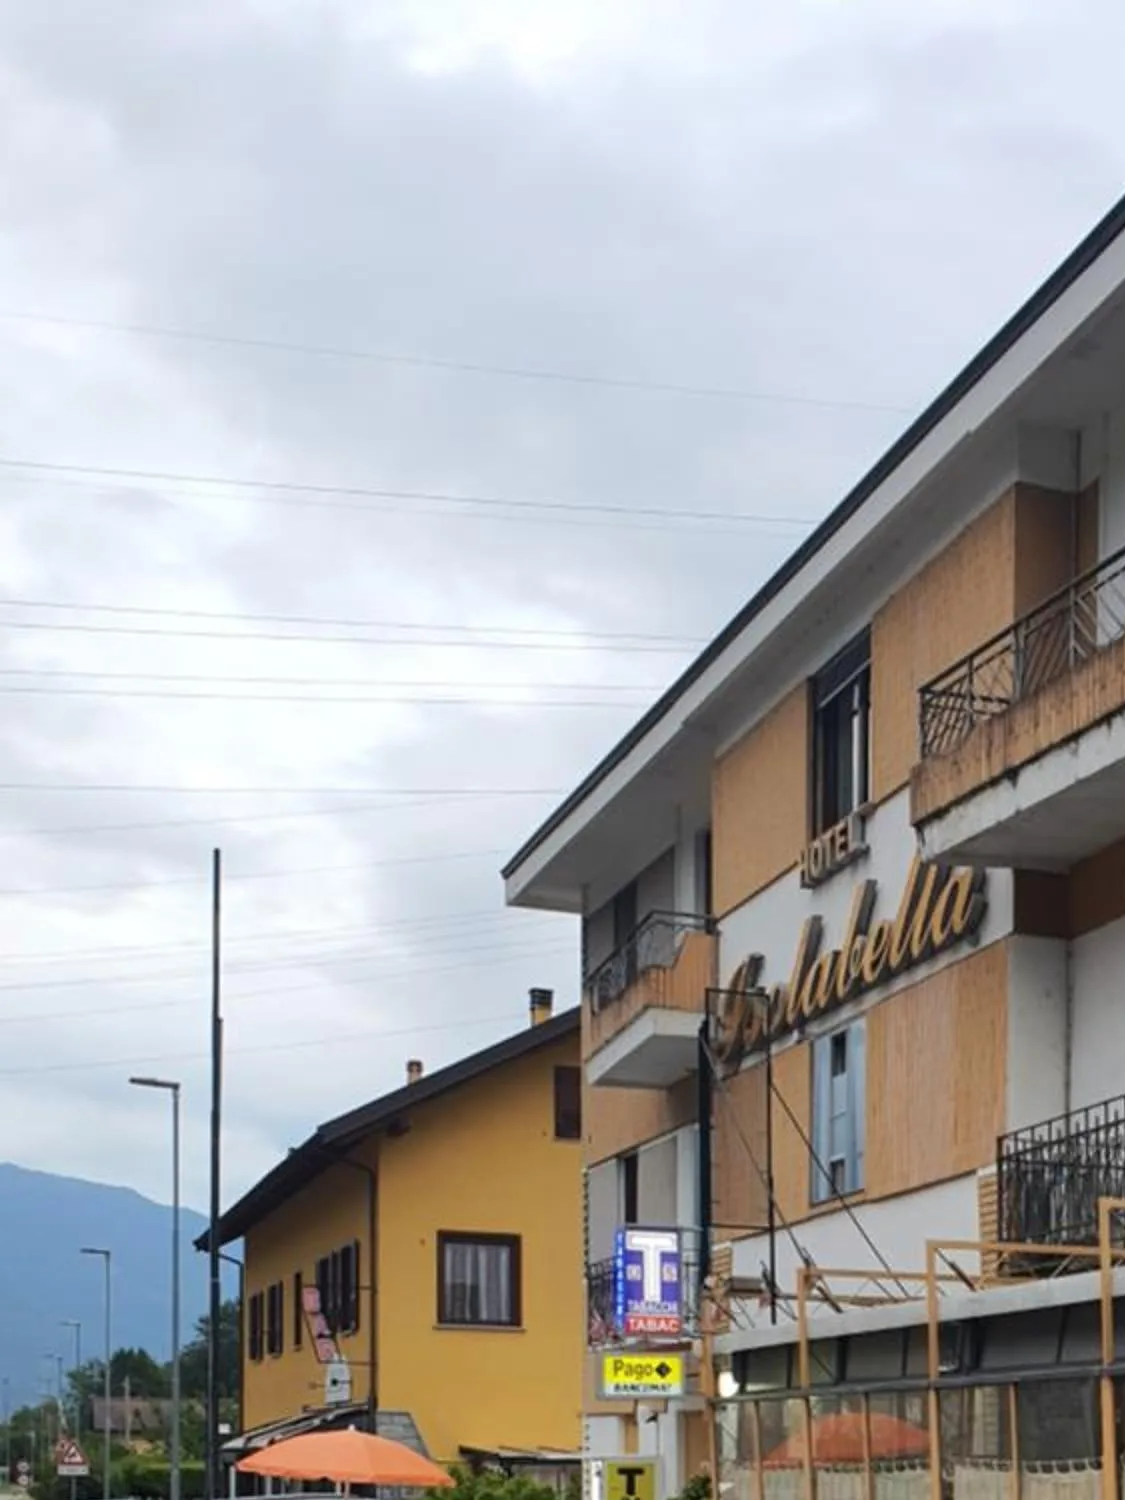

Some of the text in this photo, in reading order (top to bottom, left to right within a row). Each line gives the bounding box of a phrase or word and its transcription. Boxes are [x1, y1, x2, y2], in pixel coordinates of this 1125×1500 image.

[800, 814, 869, 887] HOTEL
[625, 1231, 678, 1301] T
[628, 1318, 679, 1332] TABAC
[613, 1359, 654, 1380] Pago
[617, 1467, 645, 1496] T
